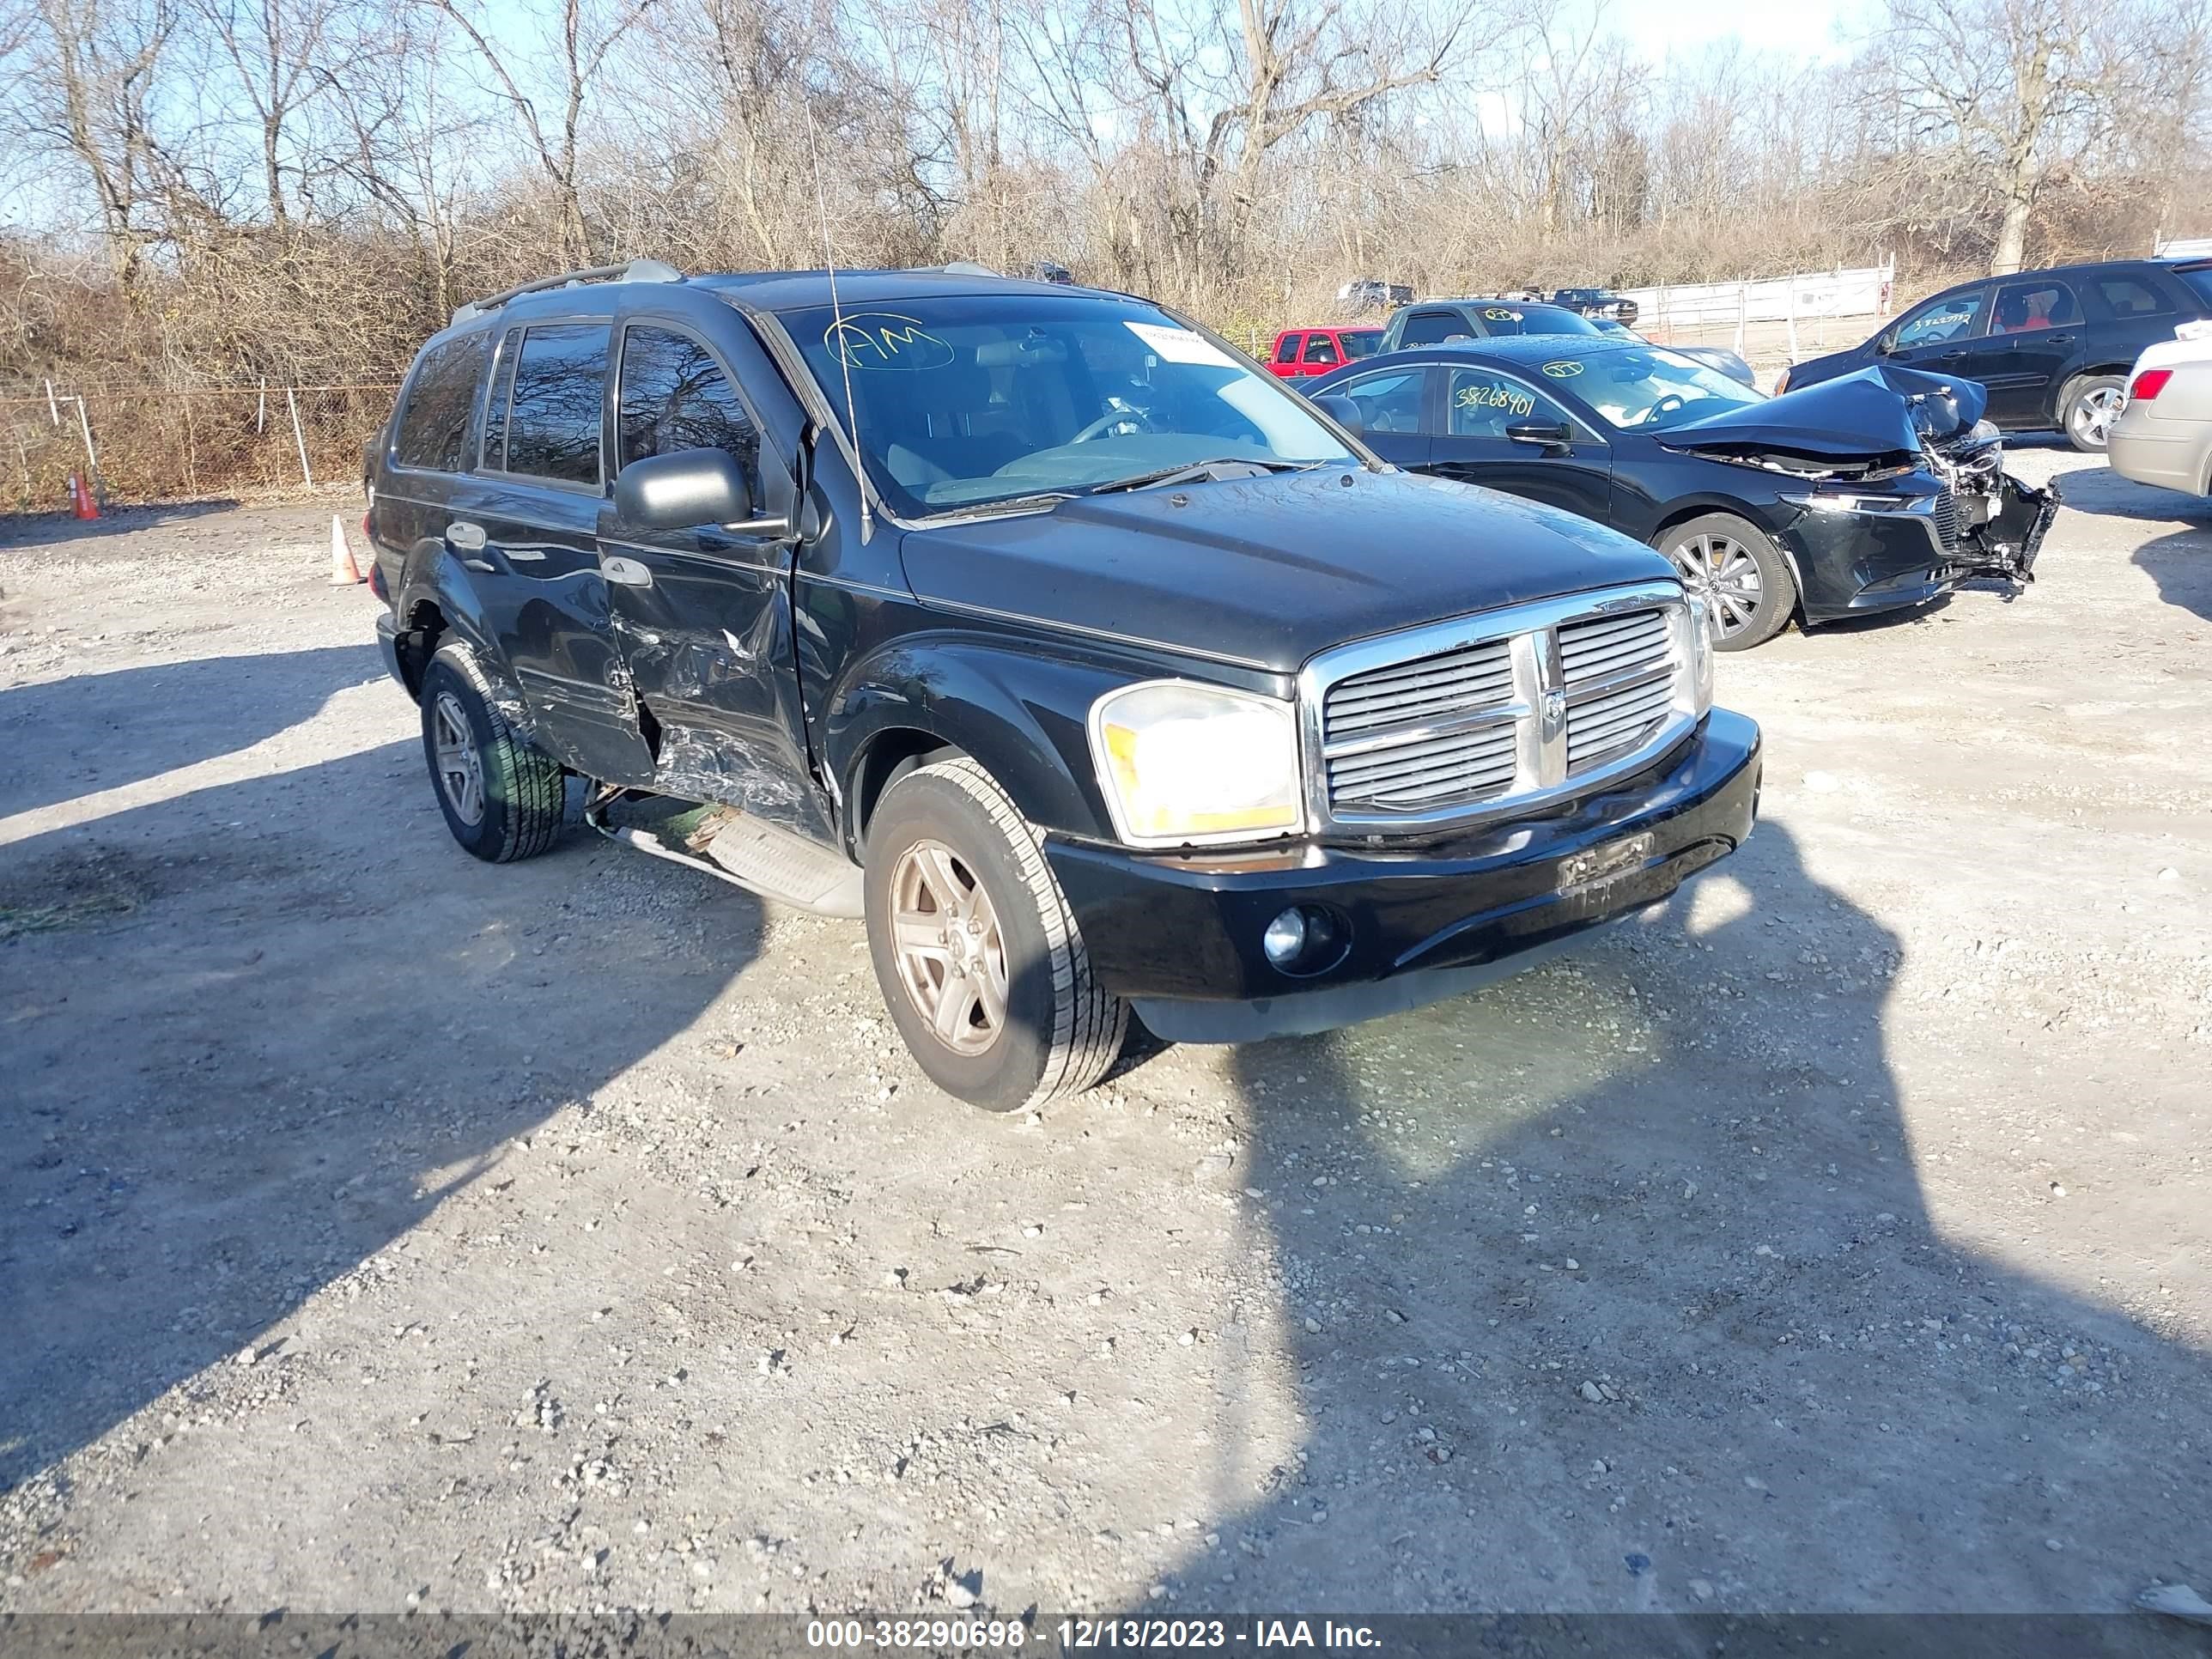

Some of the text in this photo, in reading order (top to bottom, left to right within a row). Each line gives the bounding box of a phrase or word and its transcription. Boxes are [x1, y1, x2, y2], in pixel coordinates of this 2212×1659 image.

[839, 324, 943, 367] AM
[1545, 362, 1581, 376] JT
[1455, 387, 1536, 416] 38268401
